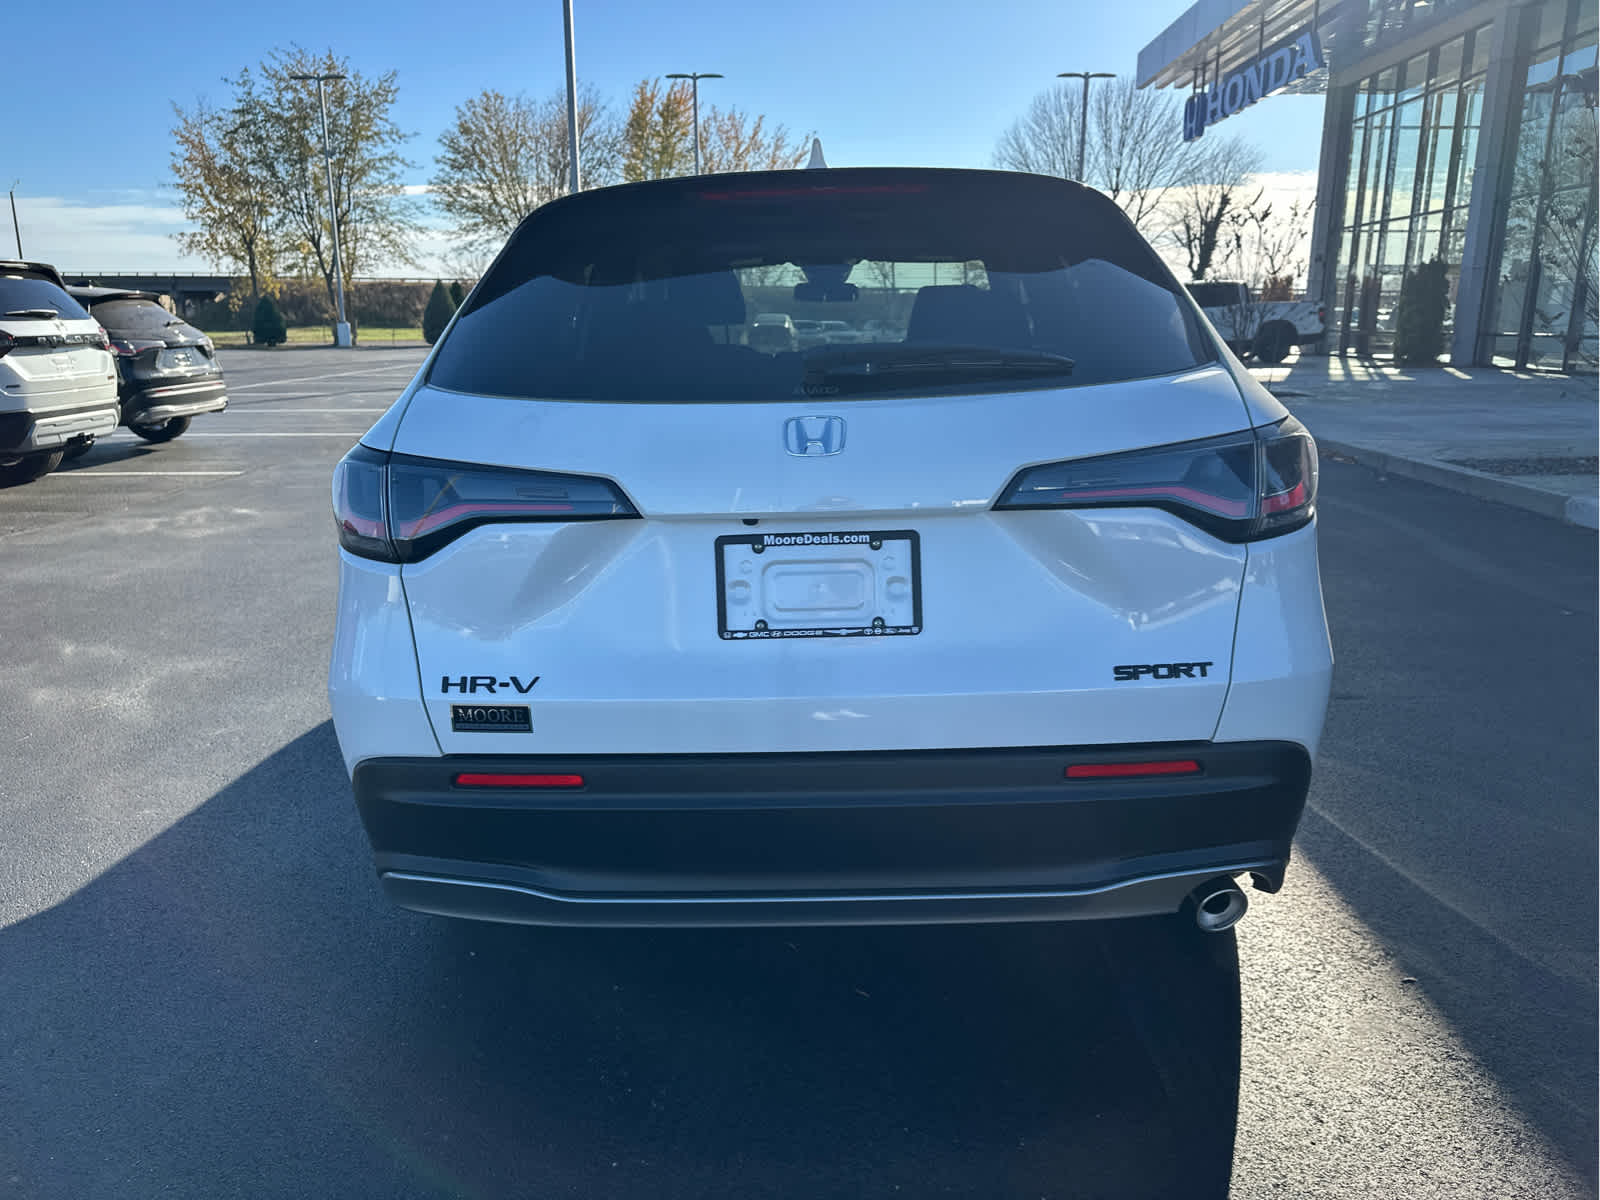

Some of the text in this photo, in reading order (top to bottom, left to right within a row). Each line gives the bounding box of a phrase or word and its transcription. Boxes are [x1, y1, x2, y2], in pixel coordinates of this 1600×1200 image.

[1204, 31, 1319, 126] HONDA
[763, 533, 870, 546] MooreDeals.com
[1113, 661, 1214, 681] SPORT
[441, 676, 540, 694] HR-V
[457, 708, 524, 723] MOORE
